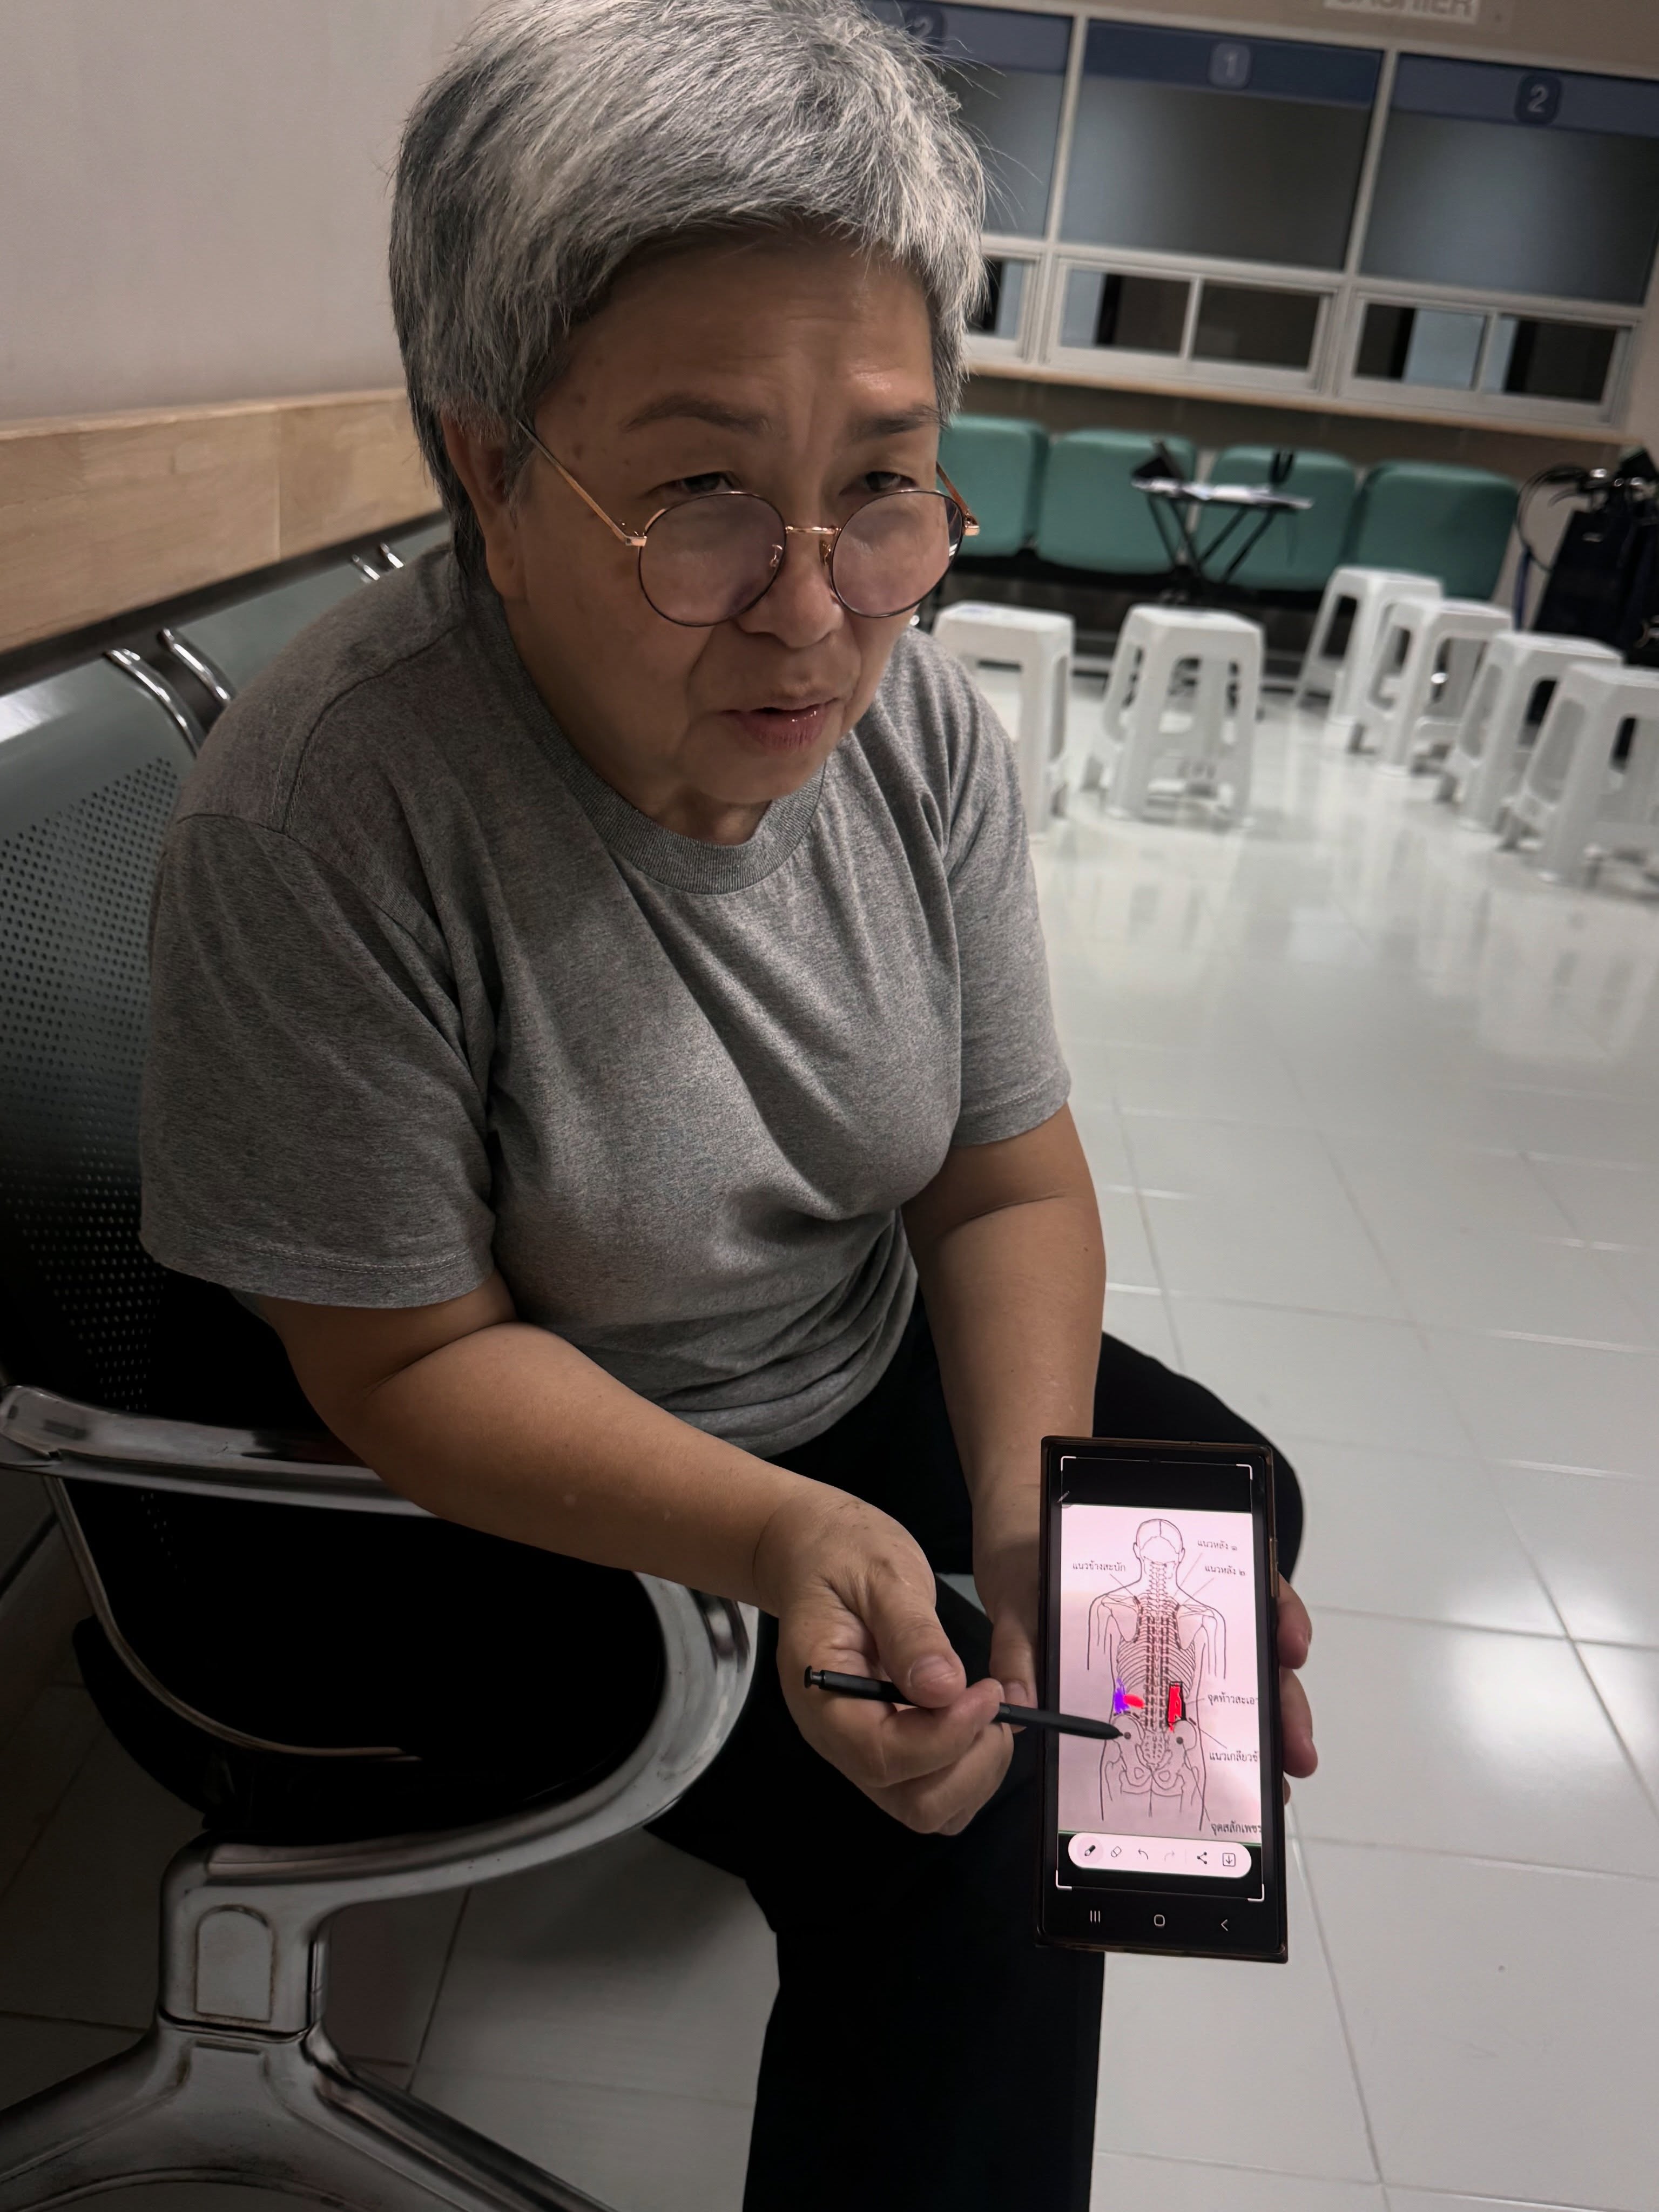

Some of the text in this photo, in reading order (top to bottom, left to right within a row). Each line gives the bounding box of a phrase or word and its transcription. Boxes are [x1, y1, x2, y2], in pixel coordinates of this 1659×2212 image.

[1223, 51, 1238, 78] 1
[1527, 84, 1548, 113] 2
[1197, 1540, 1229, 1549] แนวหลัง
[1073, 1559, 1126, 1572] แนวข้างสะบัก
[1205, 1565, 1236, 1575] แนวหลัง
[1208, 1691, 1258, 1706] จุดท้าวสะเอ
